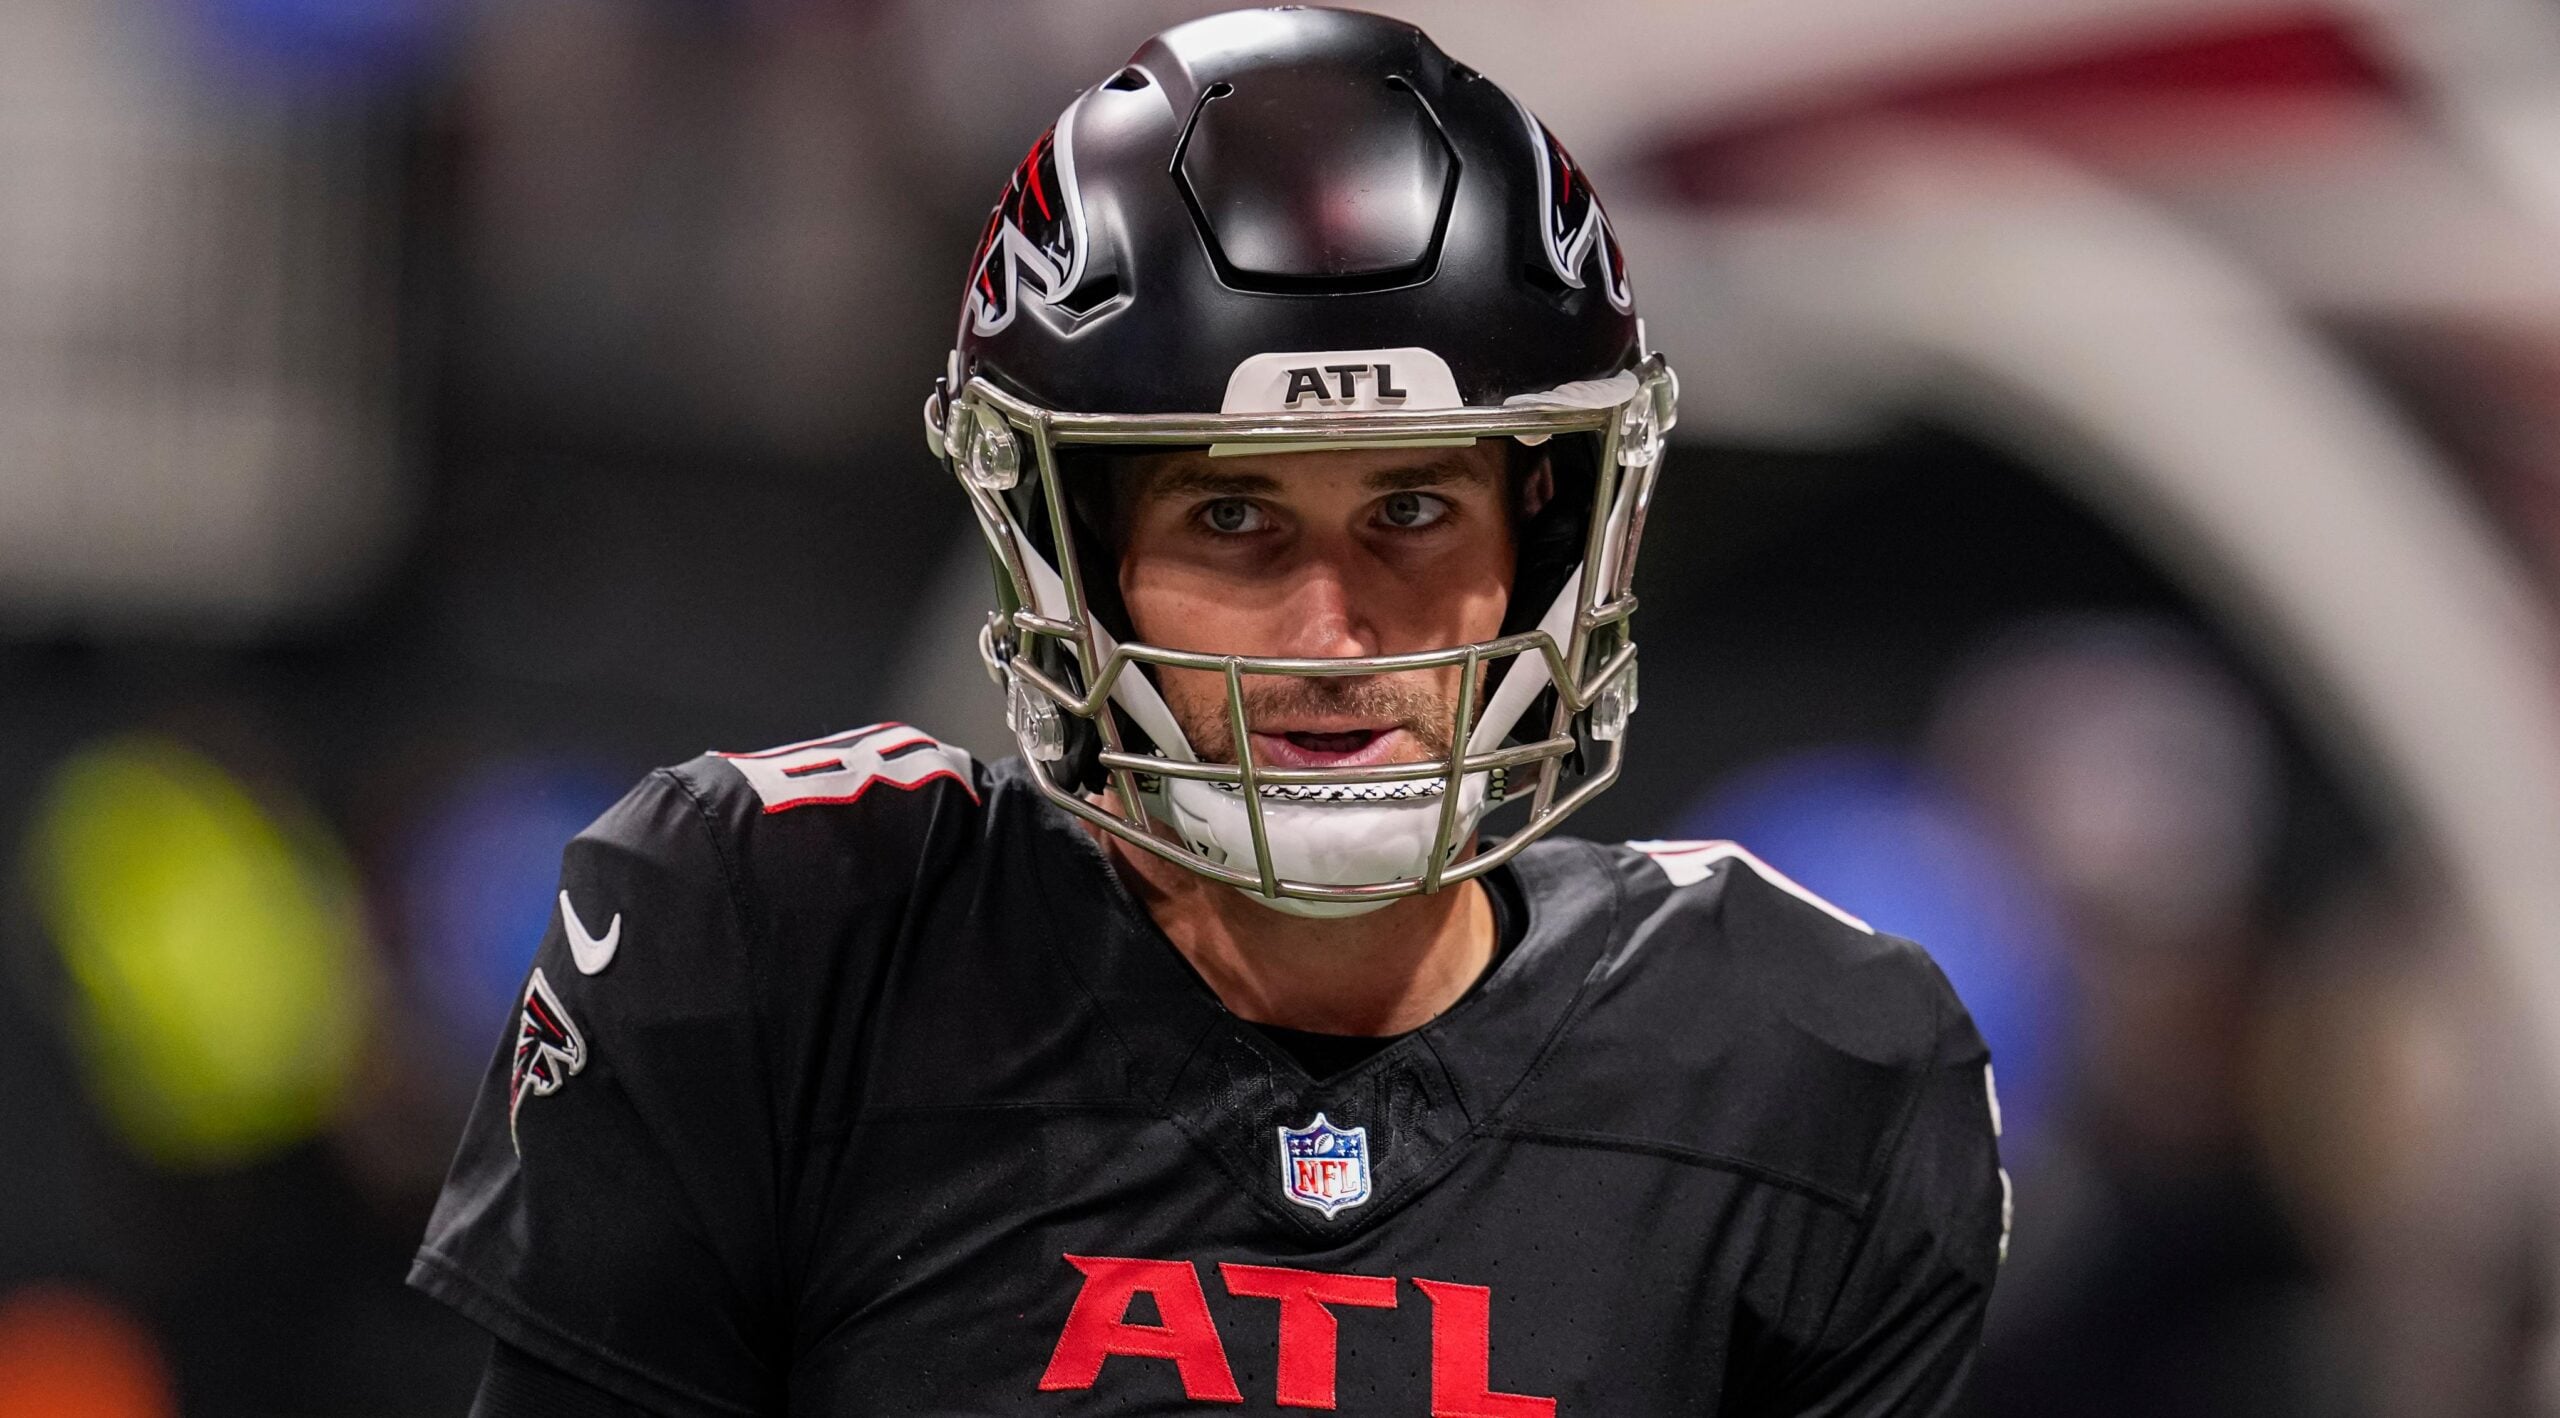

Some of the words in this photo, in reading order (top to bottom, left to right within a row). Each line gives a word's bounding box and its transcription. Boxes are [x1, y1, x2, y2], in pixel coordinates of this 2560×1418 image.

[1283, 364, 1408, 404] ATL
[1296, 1160, 1357, 1198] NFL
[1038, 1254, 1558, 1418] ATL
